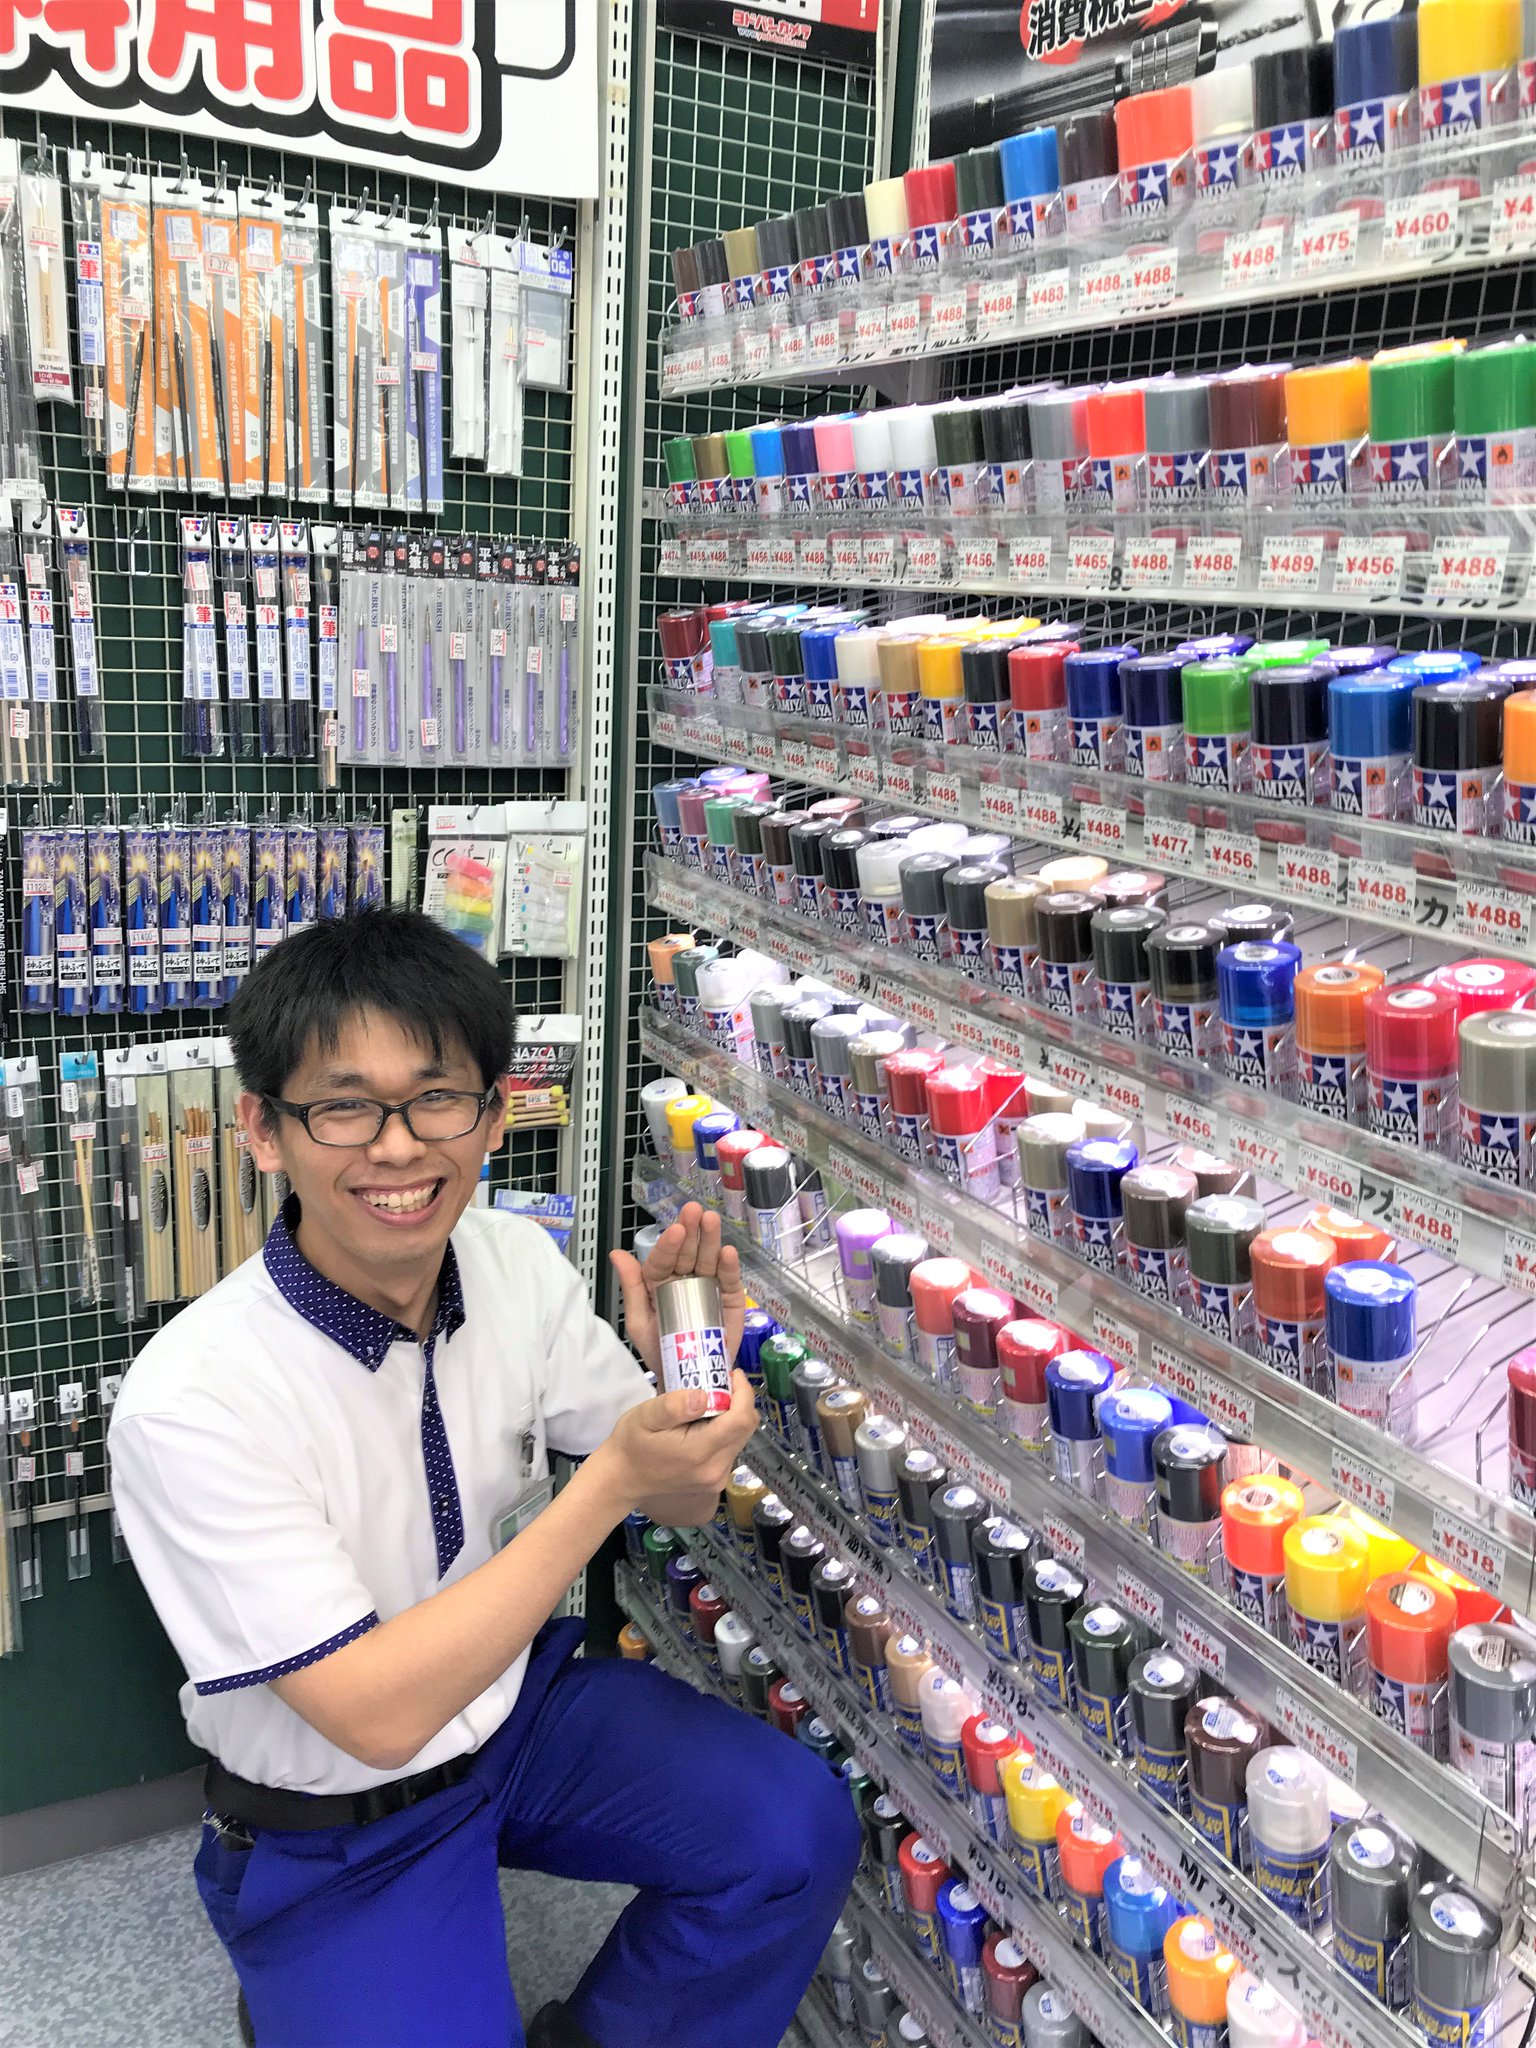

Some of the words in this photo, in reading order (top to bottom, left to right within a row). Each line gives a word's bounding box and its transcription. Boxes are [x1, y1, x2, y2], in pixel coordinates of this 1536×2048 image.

[732, 9, 811, 39] ヨドバシカメラ
[1504, 194, 1534, 218] ¥4
[1395, 212, 1449, 236] ¥460
[1302, 230, 1350, 254] ¥475
[1231, 246, 1275, 267] ¥488
[80, 259, 99, 279] 筆
[1134, 266, 1171, 286] ¥488
[1087, 275, 1121, 293] ¥488
[984, 297, 1012, 312] ¥488
[1033, 287, 1064, 303] ¥483
[936, 305, 962, 320] ¥488
[891, 317, 915, 330] ¥488
[342, 531, 354, 563] 面相筆
[354, 549, 367, 562] 細
[408, 541, 422, 570] 丸筆
[478, 547, 491, 574] 平筆
[515, 550, 526, 577] 平筆
[547, 552, 560, 578] 平筆
[837, 552, 857, 564] ¥465
[868, 552, 890, 564] ¥477
[913, 553, 936, 565] ¥488
[1015, 554, 1045, 567] ¥488
[1075, 553, 1107, 569] ¥465
[1131, 554, 1167, 570] ¥488
[1193, 554, 1232, 570] ¥488
[1270, 556, 1314, 572] ¥489
[1346, 557, 1394, 574] ¥456
[1441, 558, 1496, 576] ¥488
[196, 606, 212, 623] 筆
[295, 608, 305, 618] 筆
[371, 581, 379, 628] Mr.BRUSH
[322, 620, 337, 637] 筆
[887, 776, 910, 790] ¥488
[931, 786, 956, 802] ¥488
[1331, 792, 1362, 813] MIYA
[985, 797, 1014, 815] ¥488
[1027, 807, 1057, 824] ¥488
[1413, 807, 1456, 828] AMIYA
[1087, 820, 1120, 839] ¥488
[1152, 832, 1188, 854] ¥477
[1213, 845, 1253, 868] ¥456
[1286, 862, 1330, 885] ¥488
[1357, 877, 1406, 903] ¥488
[1467, 901, 1521, 930] ¥488
[955, 1022, 983, 1042] ¥553
[1055, 1063, 1086, 1084] ¥477
[1224, 1057, 1265, 1076] AMIYA
[1105, 1082, 1140, 1108] ¥488
[1299, 1083, 1347, 1103] AMIYA
[1173, 1111, 1210, 1138] ¥456
[1368, 1106, 1417, 1130] AMIYA
[1237, 1138, 1279, 1165] ¥477
[1462, 1139, 1518, 1167] AMIYA
[1307, 1166, 1353, 1196] ¥560
[1402, 1206, 1453, 1240] ¥488
[1516, 1253, 1536, 1276] ¥4
[1023, 1279, 1053, 1304] ¥474
[681, 1371, 728, 1390] COOR
[1158, 1361, 1195, 1392] ¥590
[1209, 1391, 1248, 1424] ¥484
[1340, 1469, 1386, 1507] ¥513
[1443, 1530, 1494, 1573] ¥518
[1184, 1632, 1220, 1665] ¥484
[1304, 1727, 1349, 1767] ¥546
